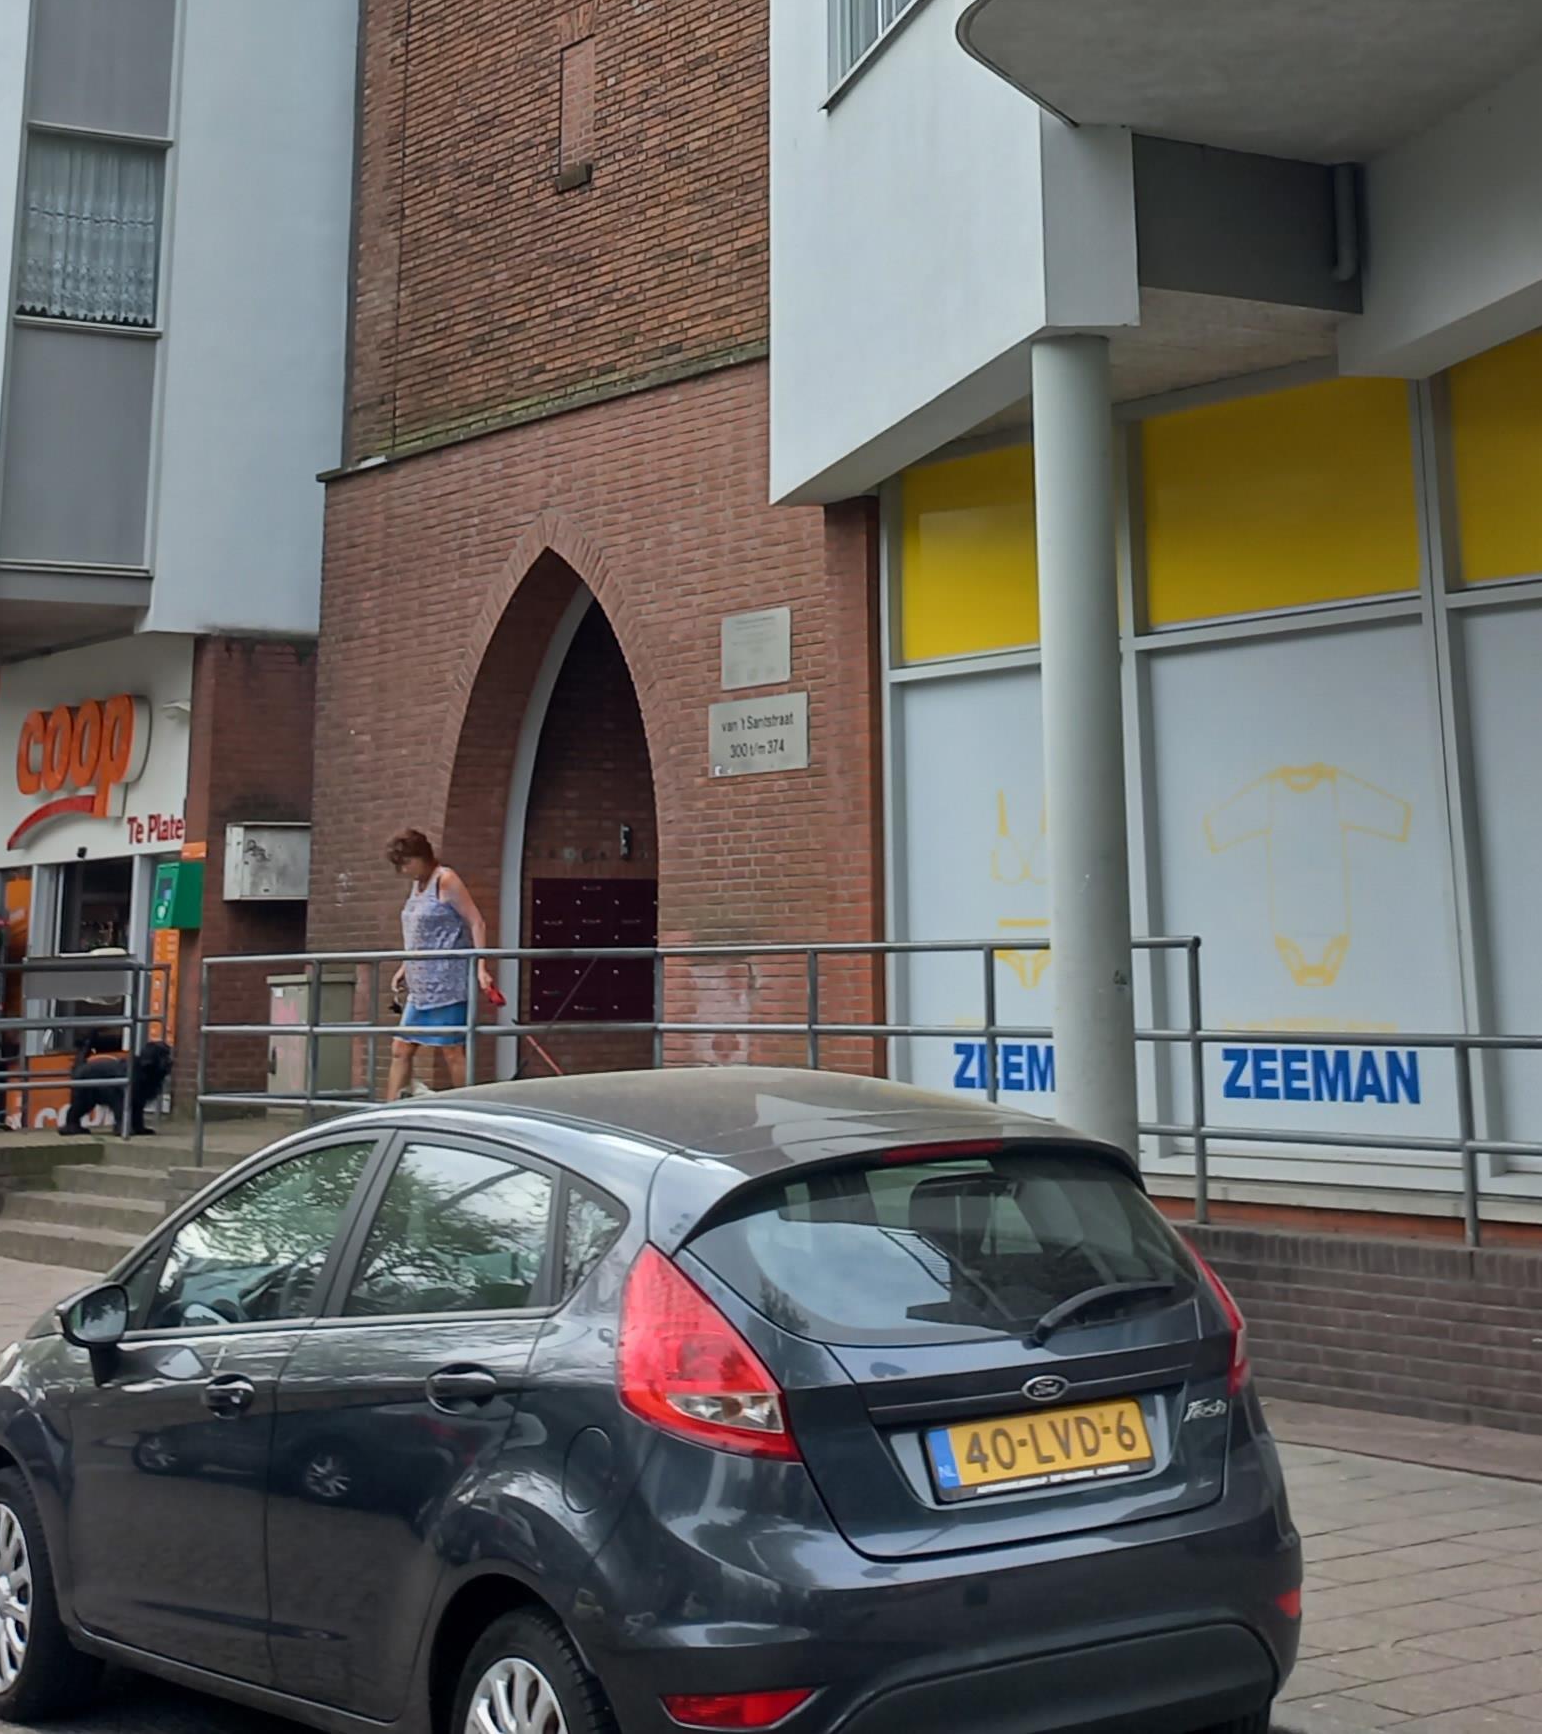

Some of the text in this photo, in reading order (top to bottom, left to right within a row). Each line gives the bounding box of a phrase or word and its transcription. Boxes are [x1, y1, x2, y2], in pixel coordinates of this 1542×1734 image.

[16, 692, 139, 818] coop
[127, 813, 185, 845] Te Plate
[1221, 1048, 1422, 1105] ZEEMAN
[965, 1410, 1136, 1473] 40-LVD-6
